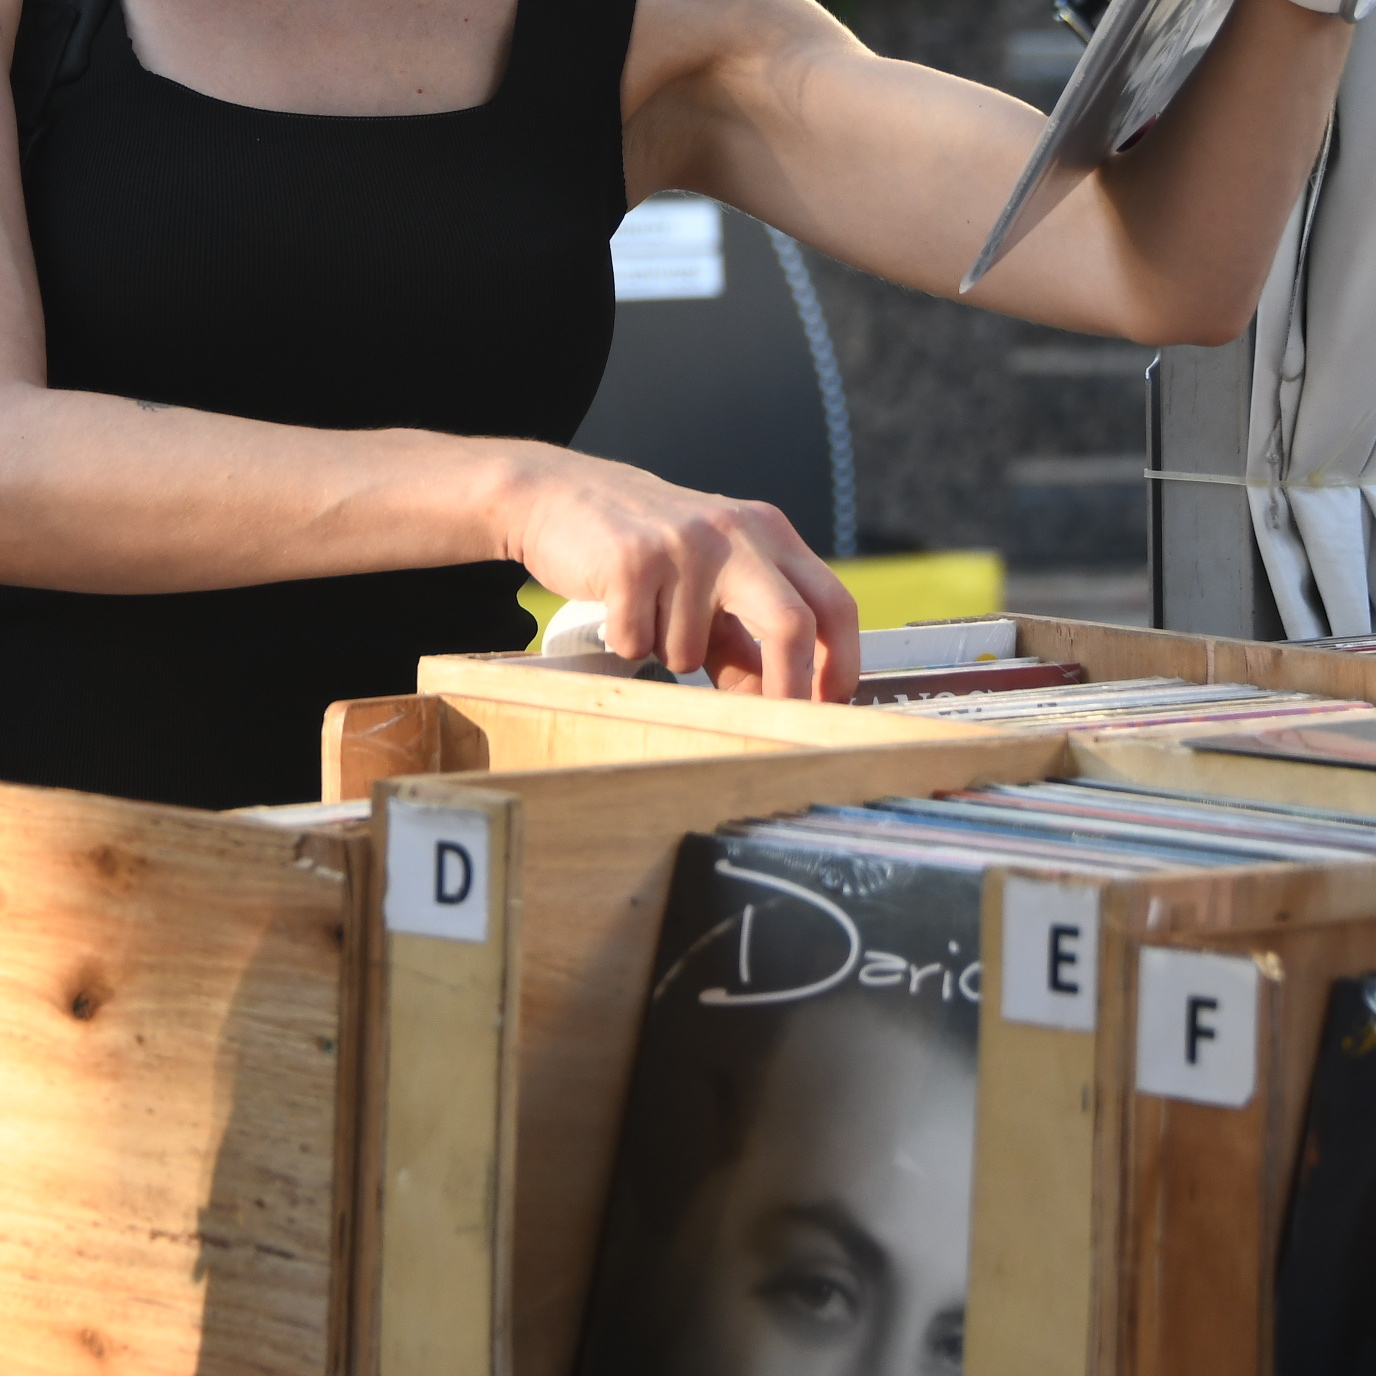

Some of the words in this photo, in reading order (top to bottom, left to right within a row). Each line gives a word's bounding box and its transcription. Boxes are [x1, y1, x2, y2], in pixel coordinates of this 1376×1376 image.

[435, 841, 472, 906] D
[1048, 925, 1080, 995] E
[1185, 996, 1217, 1066] F
